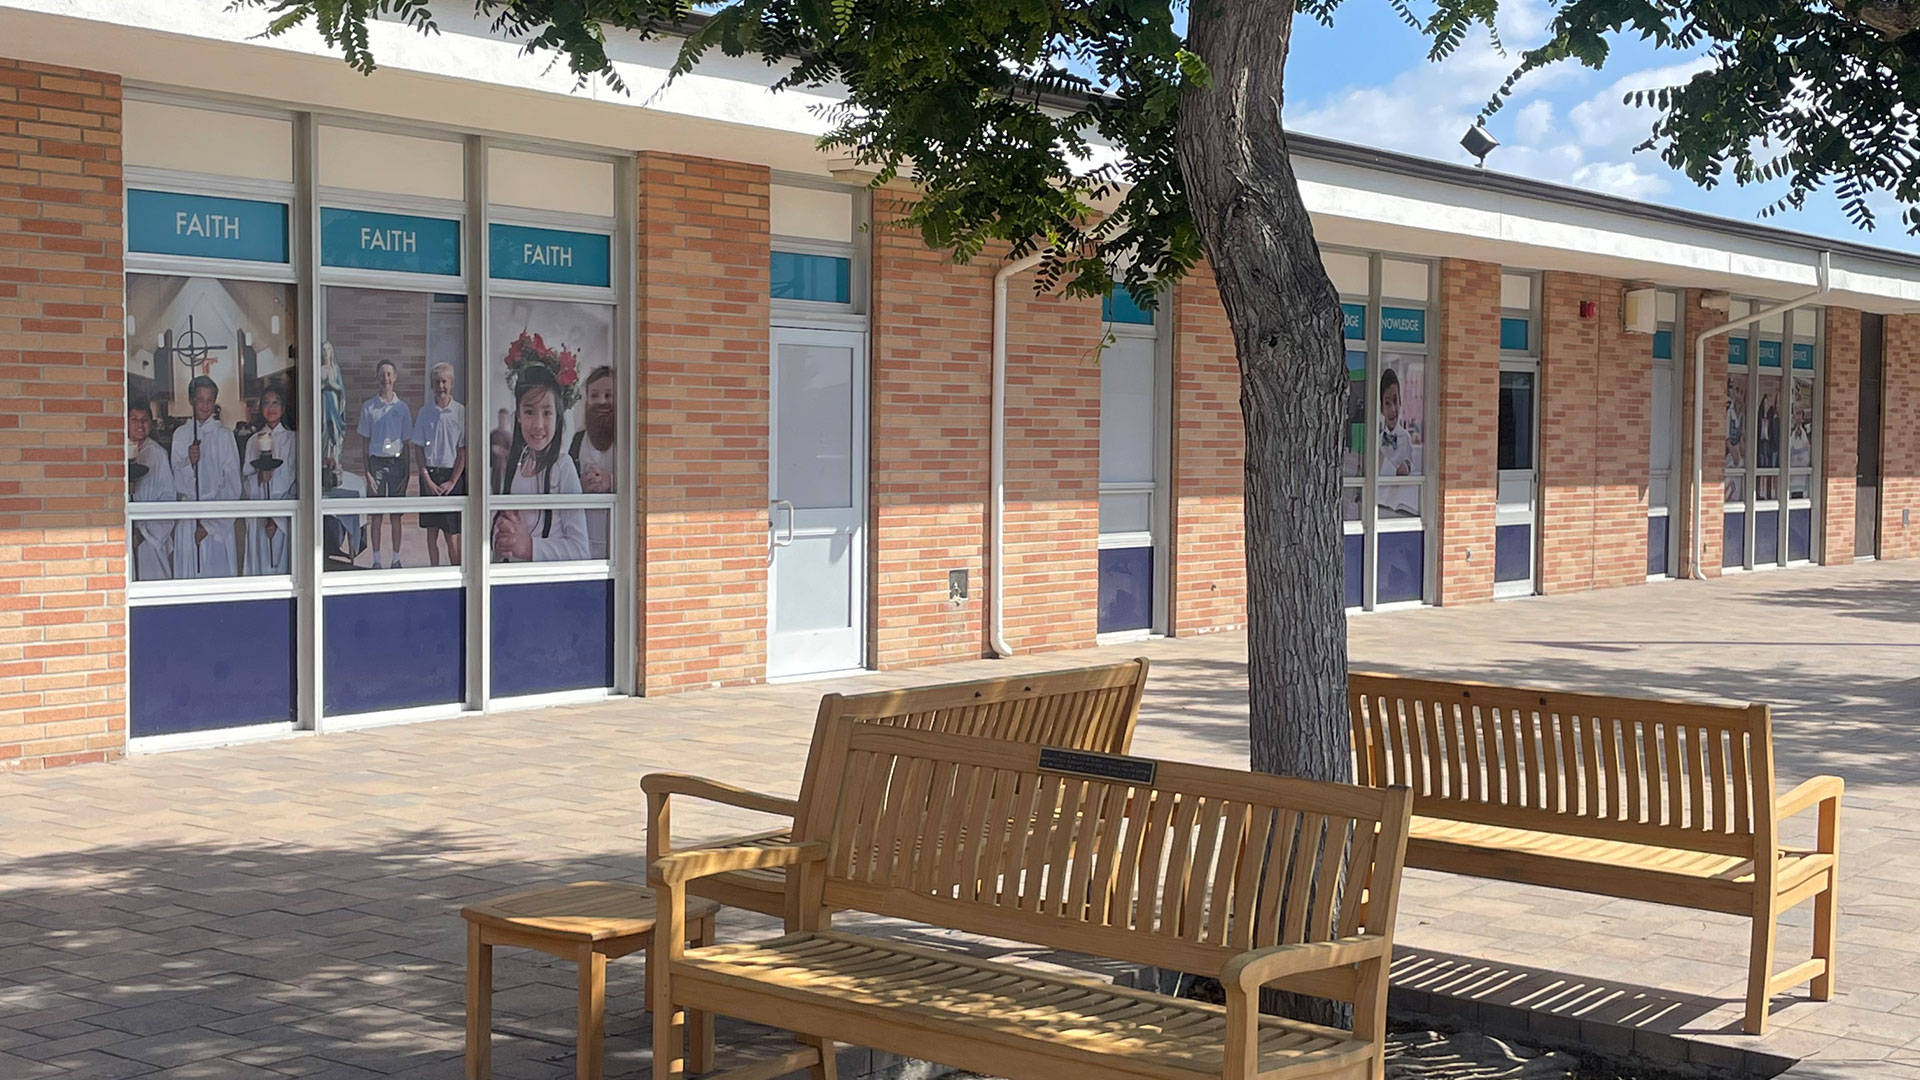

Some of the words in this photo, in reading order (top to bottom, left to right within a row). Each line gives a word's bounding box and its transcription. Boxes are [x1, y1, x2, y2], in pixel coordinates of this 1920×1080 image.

[176, 212, 240, 240] FAITH
[361, 228, 417, 254] FAITH
[523, 243, 573, 268] FAITH
[1381, 317, 1419, 331] NOWLEDGE
